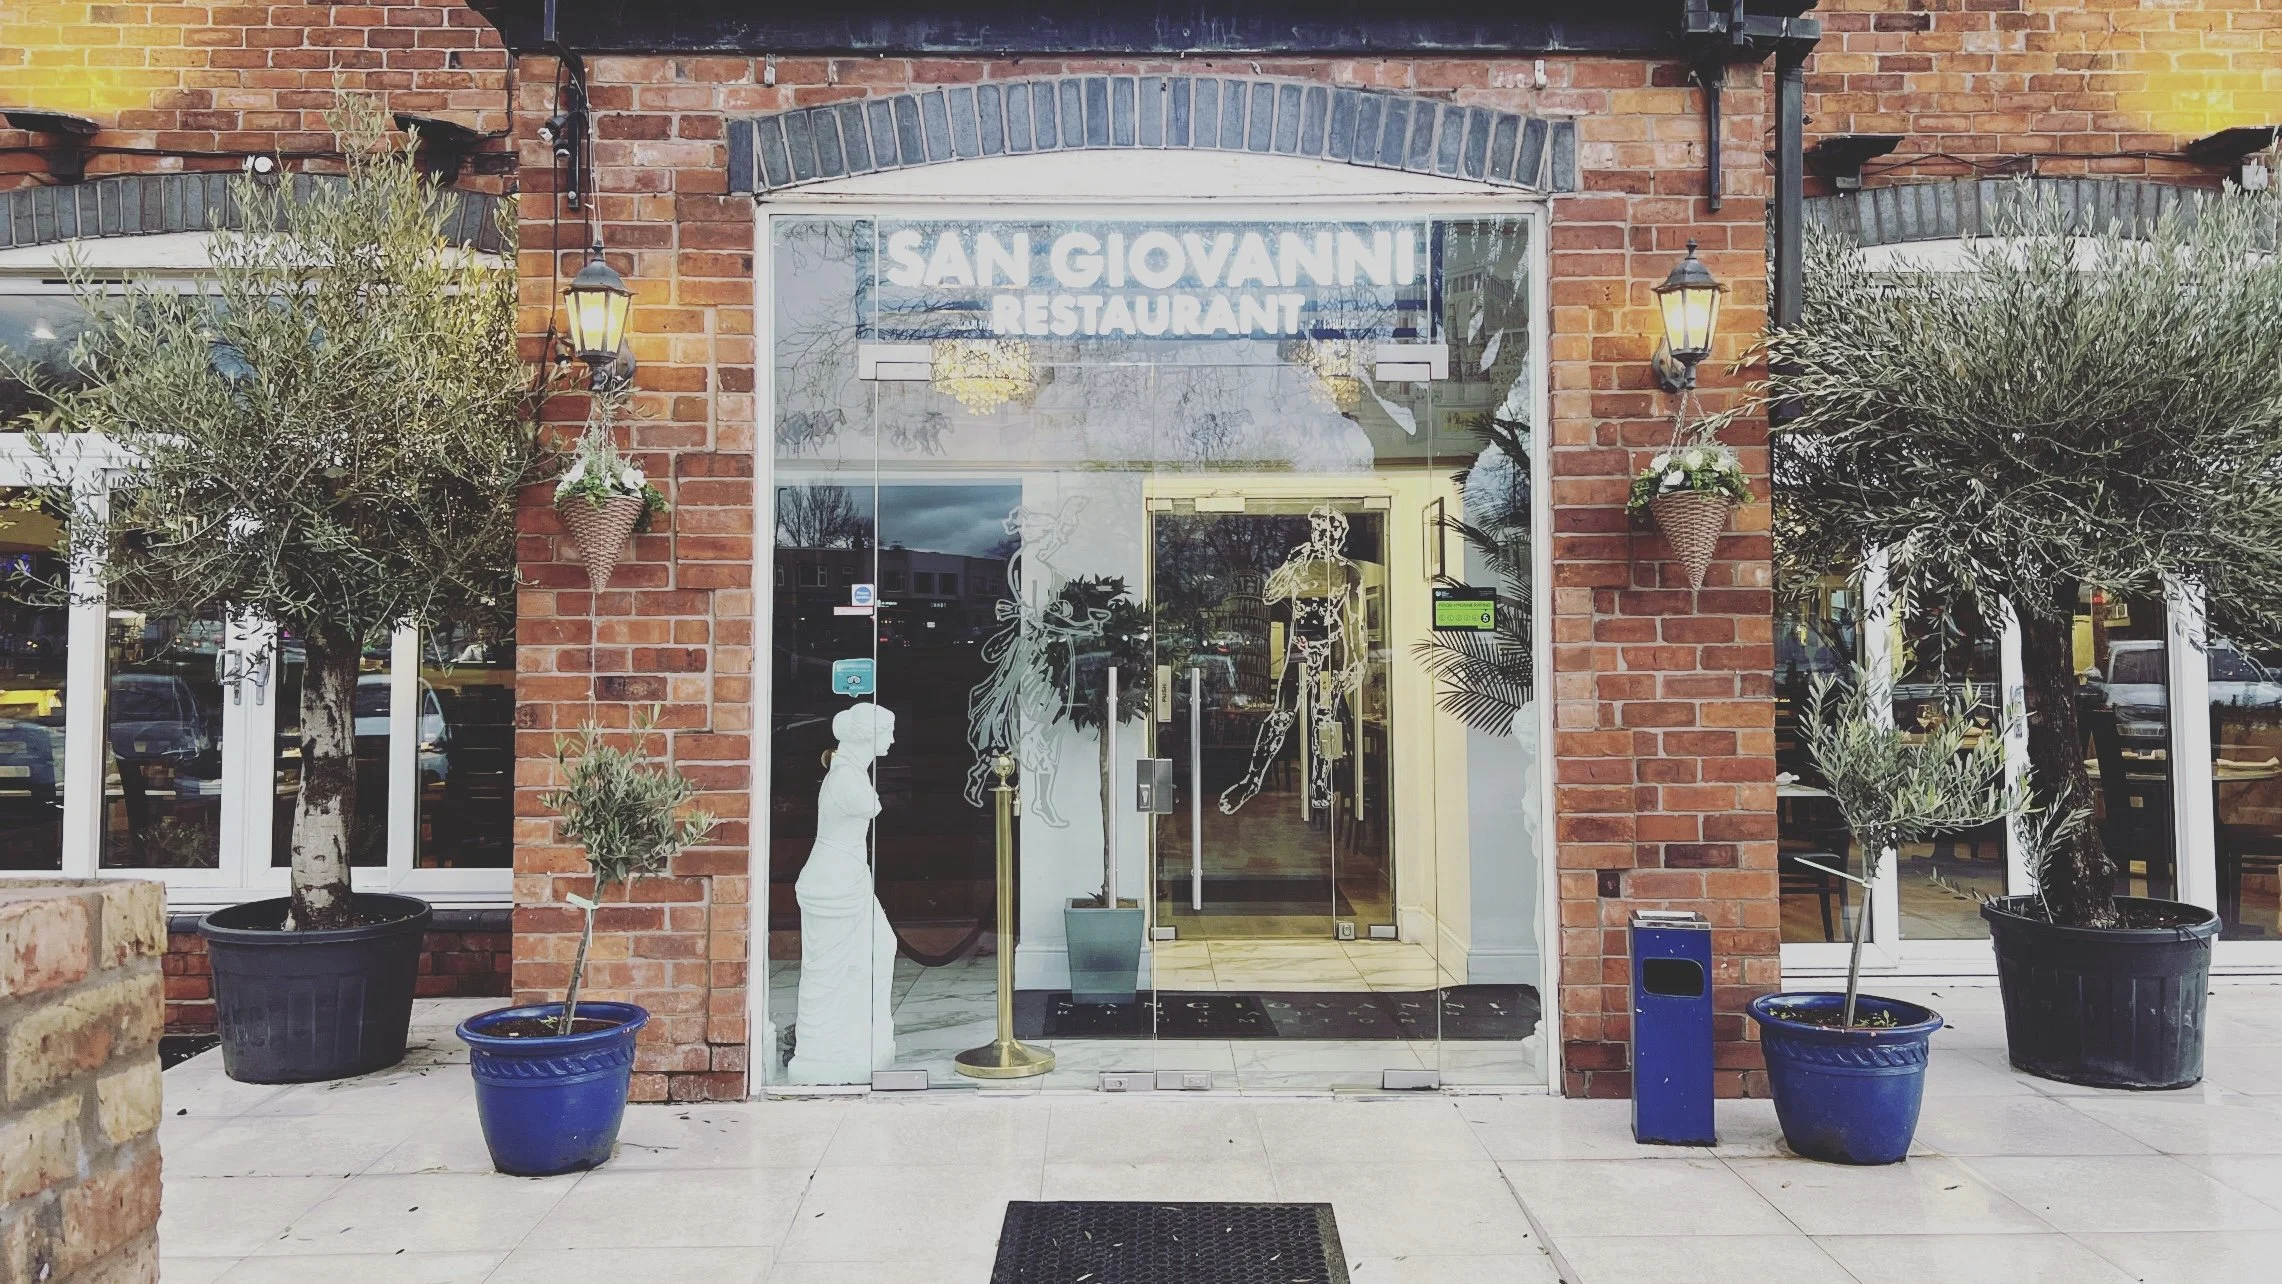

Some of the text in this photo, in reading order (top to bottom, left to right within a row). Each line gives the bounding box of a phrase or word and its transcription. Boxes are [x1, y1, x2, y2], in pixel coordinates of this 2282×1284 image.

[887, 229, 1414, 289] SAN GIOVANNI
[992, 294, 1305, 336] RESTAURANT
